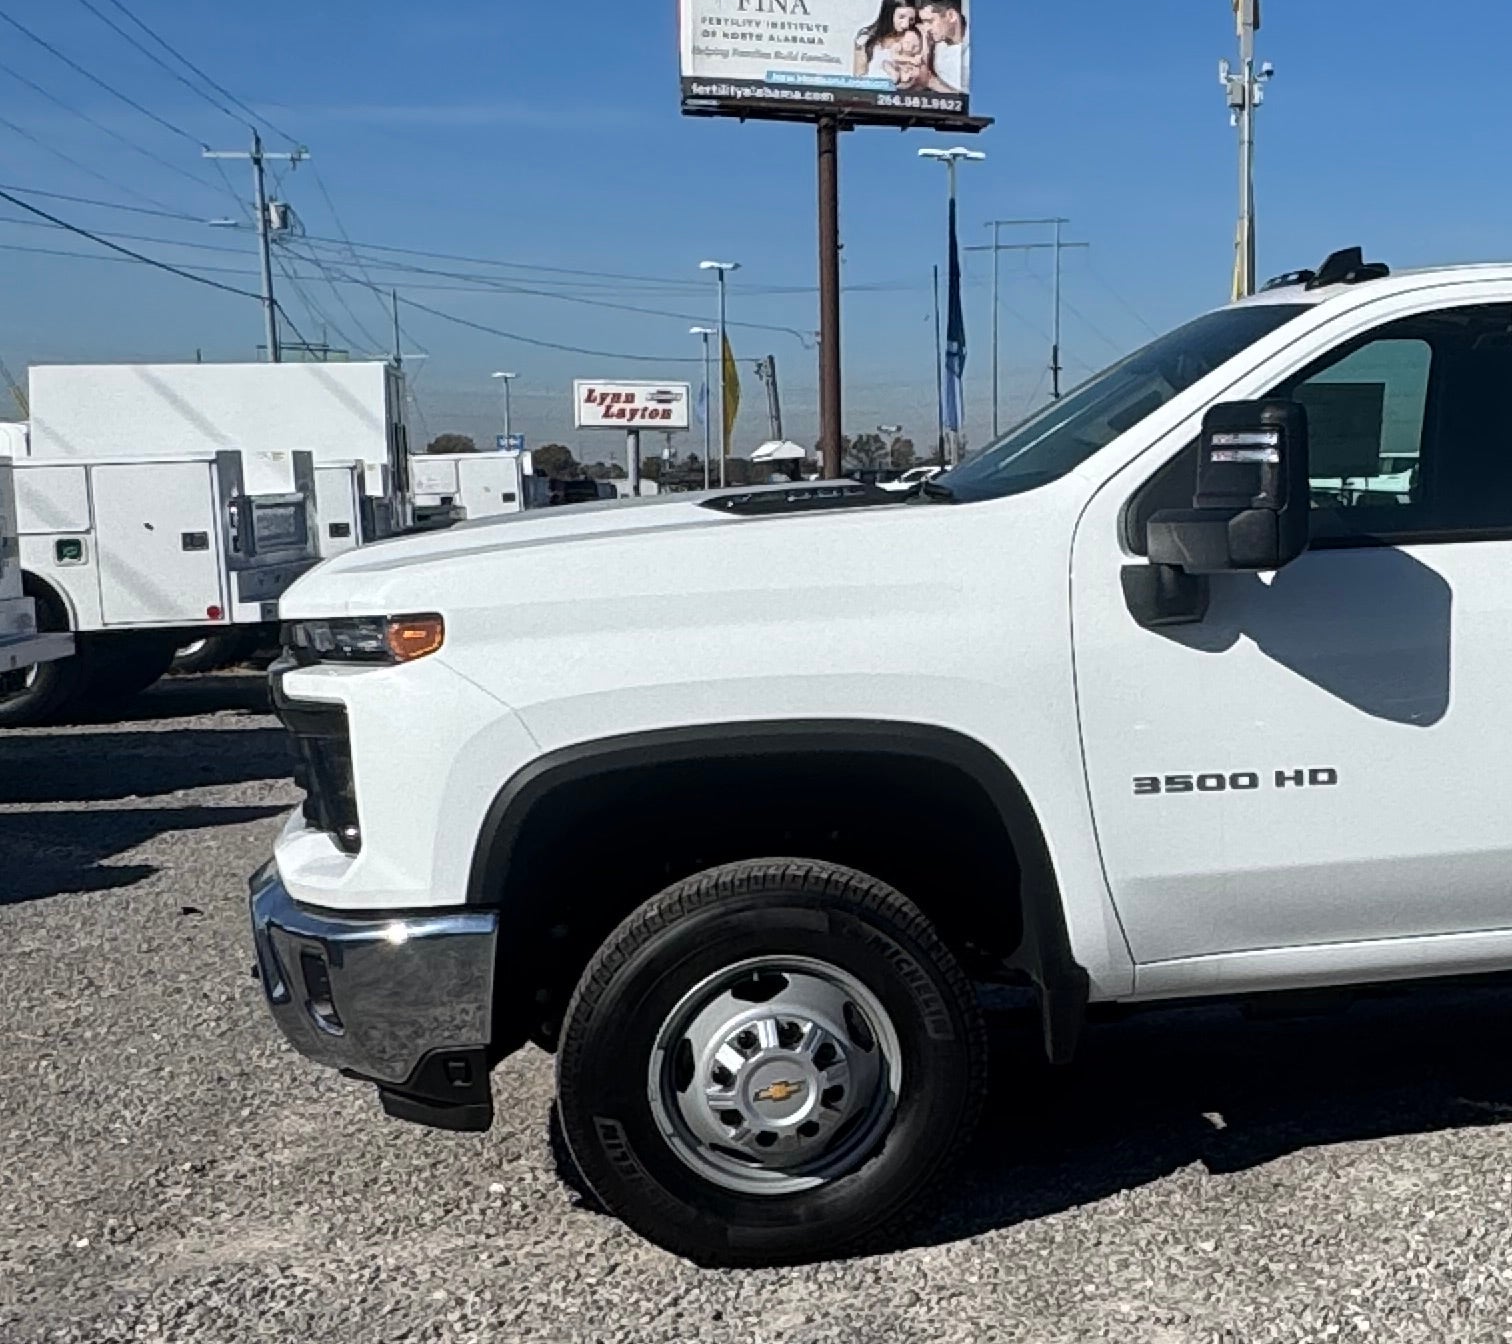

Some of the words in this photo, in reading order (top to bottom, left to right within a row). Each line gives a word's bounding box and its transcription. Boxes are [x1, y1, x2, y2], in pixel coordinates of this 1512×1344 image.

[701, 16, 762, 29] FERTILITY
[766, 20, 830, 34] INSTITUTE
[768, 34, 825, 46] ALABAMA
[584, 388, 635, 407] Lynn
[601, 404, 673, 422] Layton
[1132, 772, 1260, 795] 3500
[1274, 768, 1338, 788] HD
[865, 933, 948, 1035] MICHELIN
